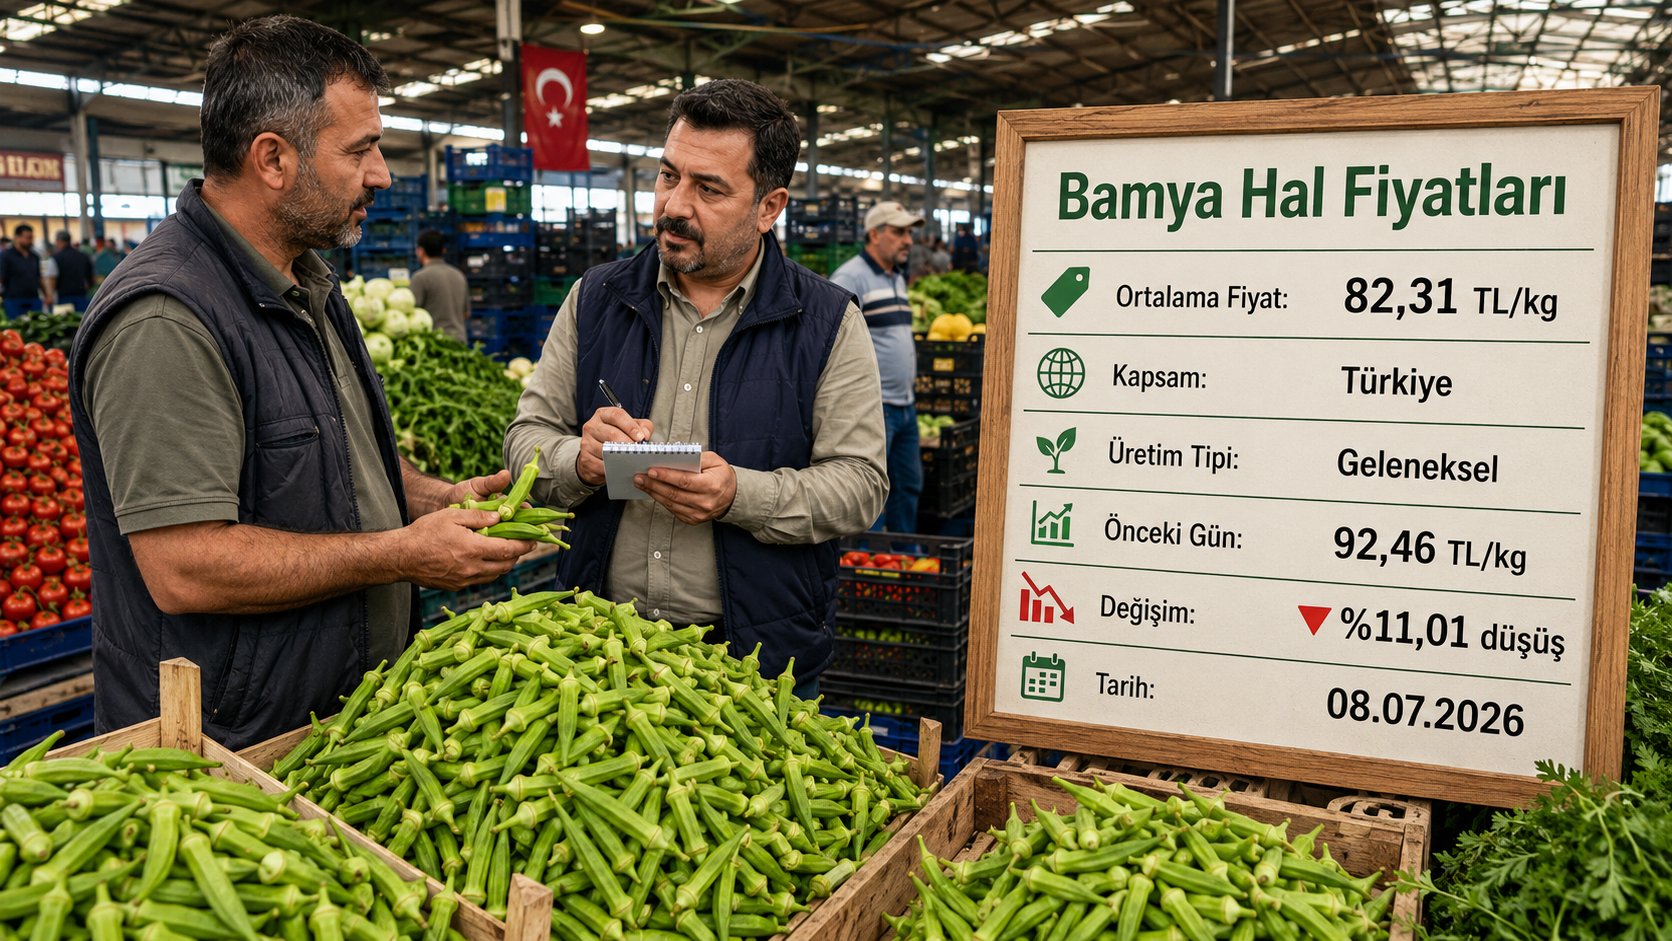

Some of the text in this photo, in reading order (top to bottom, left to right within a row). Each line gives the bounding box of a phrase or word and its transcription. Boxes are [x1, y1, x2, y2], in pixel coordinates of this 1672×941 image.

[1058, 162, 1566, 232] Bamya Hal Fiyatları
[1116, 276, 1558, 322] Ortalama Fiyat: 82,31 TL/kg
[1112, 363, 1453, 403] Kapsam: Türkiye
[1109, 435, 1498, 483] Üretim Tipi: Geleneksel
[1104, 512, 1527, 577] Önceki Gün: 92,46 TL/kg
[1100, 594, 1565, 663] Değişim: %11,01 düşüş
[1095, 671, 1525, 737] Tarih: 08.07.2026
